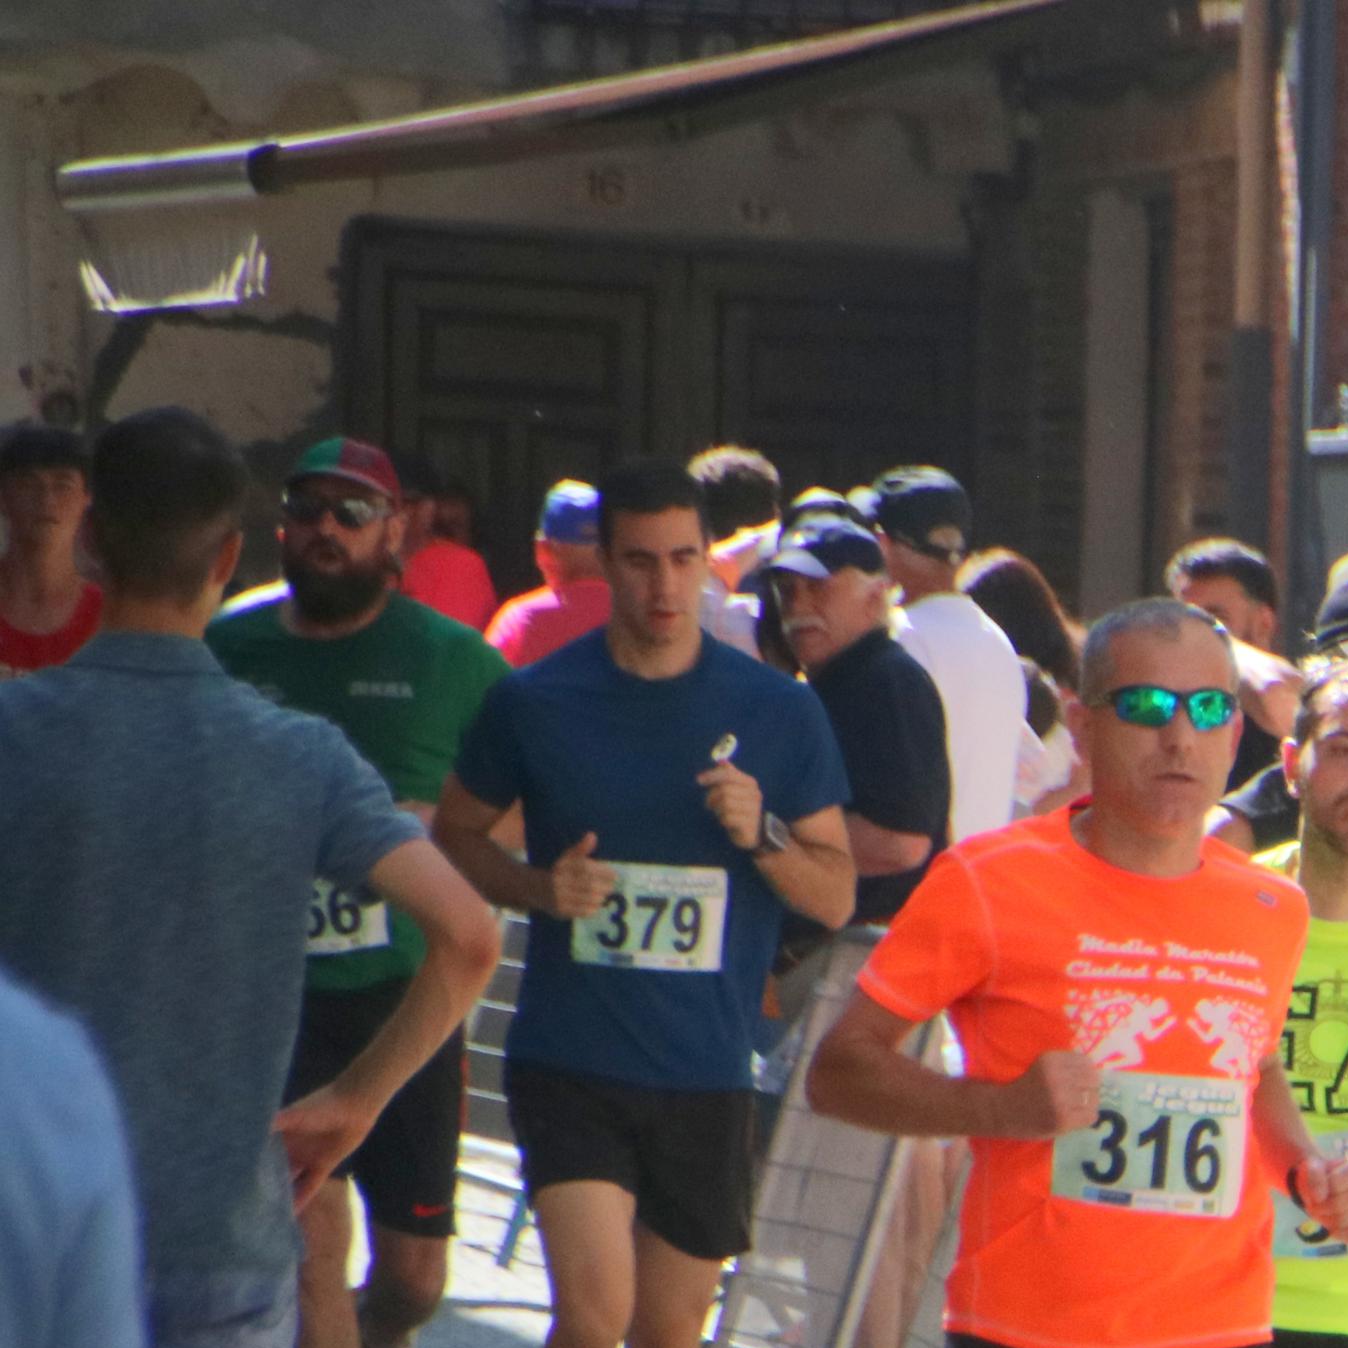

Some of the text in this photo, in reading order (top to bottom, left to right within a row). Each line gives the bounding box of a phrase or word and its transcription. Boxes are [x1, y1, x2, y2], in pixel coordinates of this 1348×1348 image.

[597, 894, 701, 953] 379
[1065, 960, 1149, 979] Ciudad
[1081, 1109, 1221, 1194] 316
